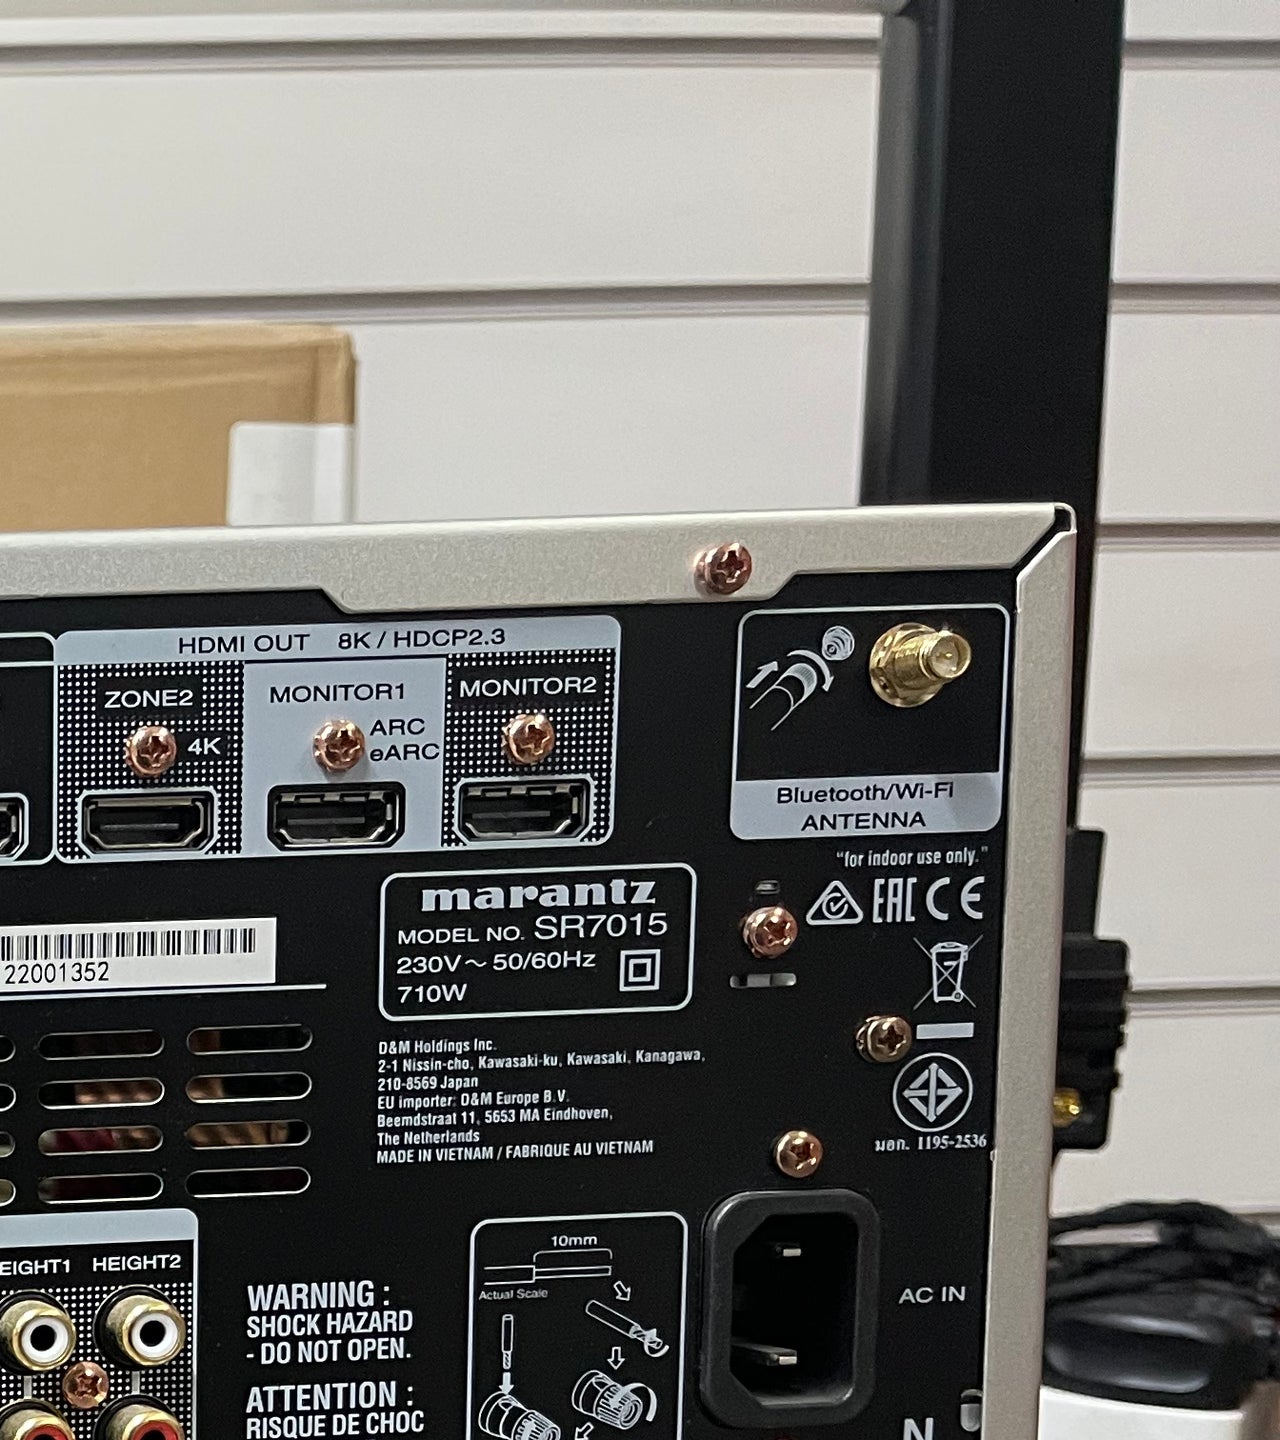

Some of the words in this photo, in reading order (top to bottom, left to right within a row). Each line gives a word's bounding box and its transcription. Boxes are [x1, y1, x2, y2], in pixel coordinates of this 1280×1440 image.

[179, 635, 245, 655] HDMI
[254, 633, 310, 652] OUT
[338, 631, 370, 650] 8K
[393, 628, 505, 649] HDCP2.3
[269, 683, 405, 704] MONITOR1
[460, 676, 597, 698] MONITOR2
[104, 689, 194, 708] ZONE2
[370, 718, 425, 736] ARC
[369, 743, 439, 762] eARC
[777, 781, 954, 804] Bluetooth/Wi-Fi
[801, 812, 926, 831] ANTENNA
[868, 849, 913, 866] indoor
[917, 851, 941, 864] use
[421, 879, 657, 913] marantz
[397, 926, 479, 946] MODEL
[486, 924, 524, 942] NO.
[534, 912, 668, 940] SR7015
[492, 950, 596, 972] 50/60Hz
[398, 983, 467, 1003] 710W
[379, 1041, 410, 1054] D&M
[414, 1040, 469, 1054] Holdings
[474, 1038, 496, 1050] Inc.
[378, 1060, 398, 1073] 2-1
[378, 1077, 437, 1091] 210-8569
[440, 1075, 478, 1091] Japan
[378, 1095, 394, 1109] EU
[460, 1092, 492, 1106] D&M
[496, 1091, 539, 1107] Europe
[377, 1111, 457, 1127] Beemdstraat
[484, 1109, 516, 1123] 5653
[520, 1109, 540, 1122] MA
[544, 1106, 613, 1122] Eindhoven,
[377, 1132, 399, 1146] The
[404, 1129, 480, 1144] Netherlands
[918, 1135, 986, 1150] 1195-2536
[377, 1150, 414, 1164] MADE
[418, 1150, 432, 1162] IN
[436, 1147, 493, 1161] VIETNAM
[505, 1144, 570, 1159] FABRIQUE
[574, 1143, 591, 1155] AU
[595, 1140, 653, 1155] VIETNAM
[551, 1235, 597, 1246] 10mm
[92, 1255, 181, 1271] HEIGHT2
[247, 1280, 374, 1311] WARNING
[899, 1288, 933, 1304] AC
[942, 1286, 966, 1301] IN
[246, 1311, 320, 1336] SHOCK
[326, 1309, 413, 1334] HAZARD
[259, 1340, 289, 1364] DO
[295, 1339, 337, 1363] NOT
[342, 1336, 411, 1360] OPEN.
[246, 1381, 399, 1413] ATTENTION
[246, 1414, 328, 1440] RISQUE
[334, 1413, 360, 1437] DE
[365, 1410, 425, 1434] CHOC
